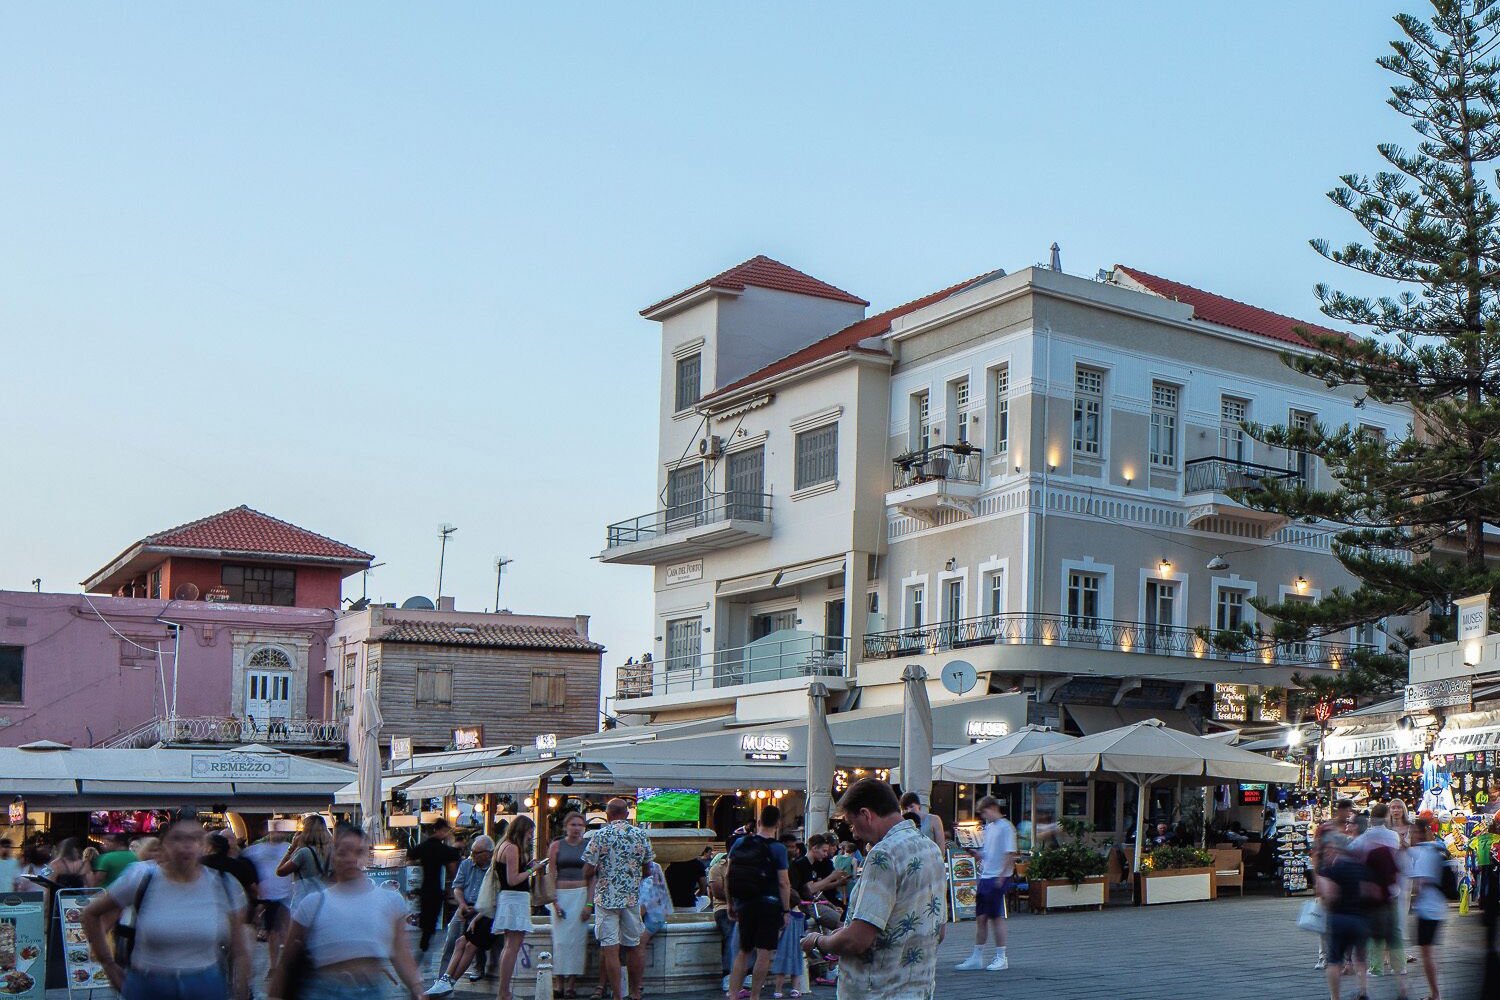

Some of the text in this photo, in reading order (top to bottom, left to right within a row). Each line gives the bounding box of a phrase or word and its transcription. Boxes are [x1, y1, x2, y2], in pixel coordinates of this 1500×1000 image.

[1462, 611, 1484, 625] MUSES
[742, 735, 790, 751] MUSES
[210, 762, 272, 772] REMEZZO
